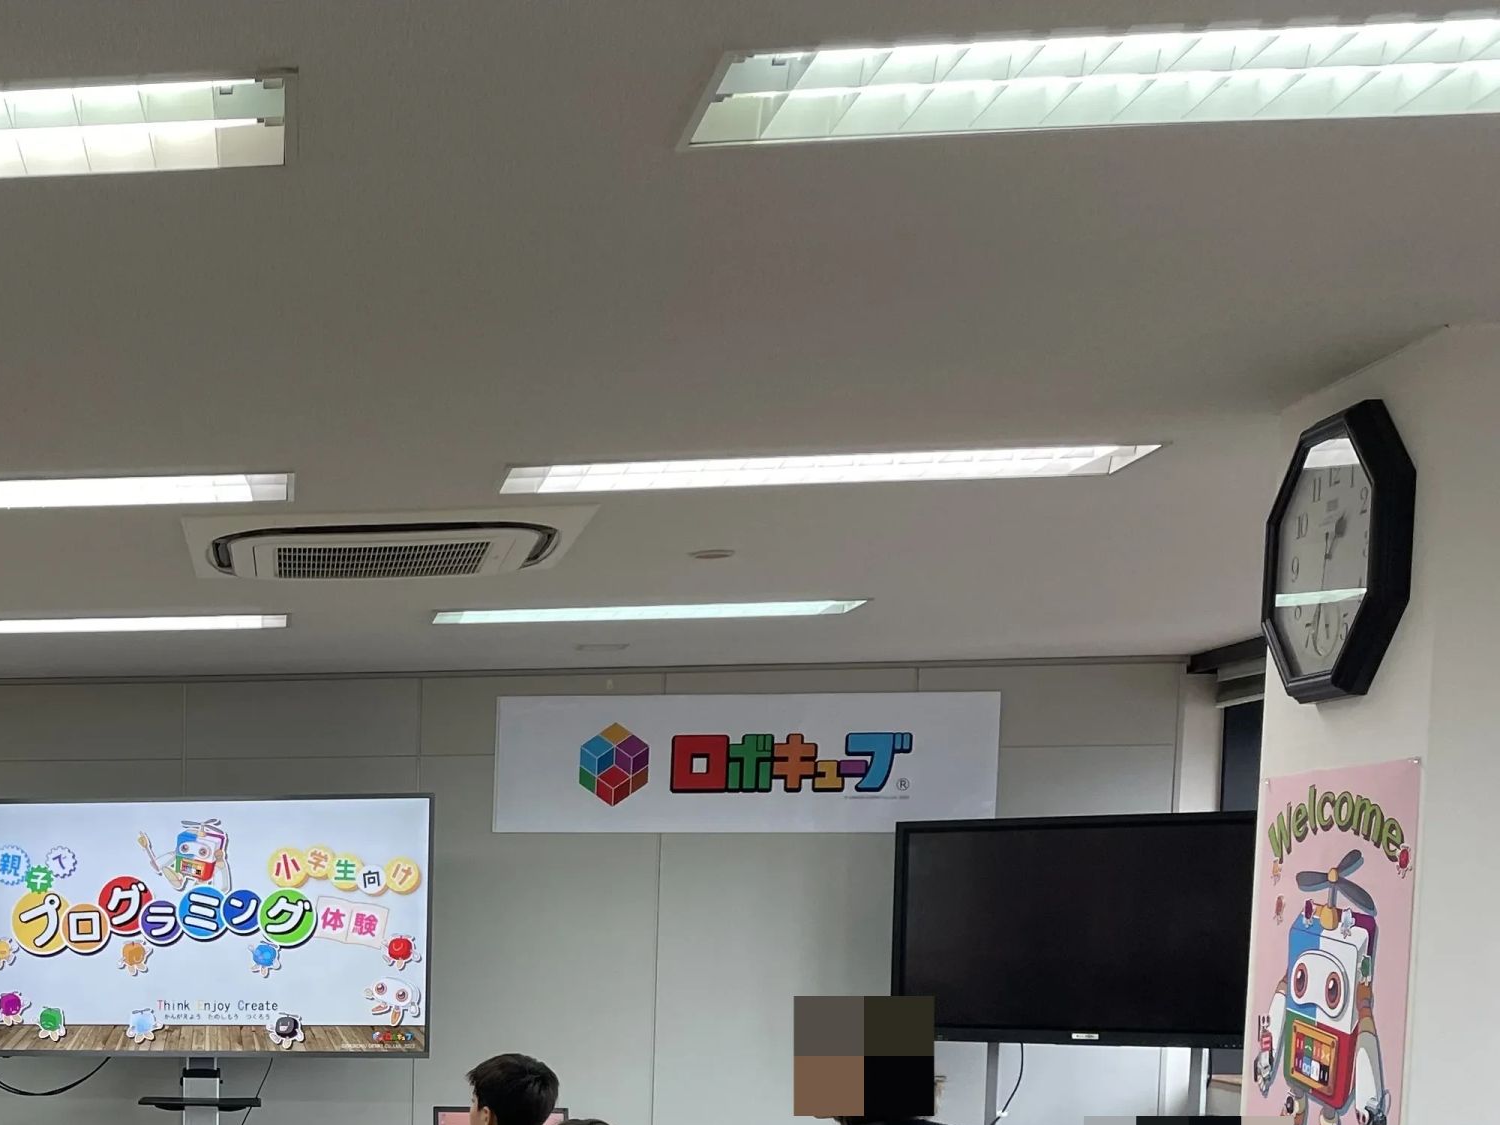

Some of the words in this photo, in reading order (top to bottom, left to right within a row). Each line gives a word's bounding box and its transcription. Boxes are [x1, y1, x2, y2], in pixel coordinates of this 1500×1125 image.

[1311, 476, 1322, 503] 11
[1328, 467, 1341, 488] 12
[1359, 487, 1368, 515] 2
[1296, 512, 1309, 540] 10
[1291, 556, 1300, 583] 9
[670, 731, 913, 793] ロボキューブ
[1267, 784, 1405, 864] Welcome
[0, 852, 67, 890] 親子で
[274, 850, 413, 889] 小学生向け
[18, 880, 312, 949] プログラミング
[321, 907, 379, 937] 体験
[157, 1000, 190, 1011] Think
[237, 1000, 279, 1012] Create
